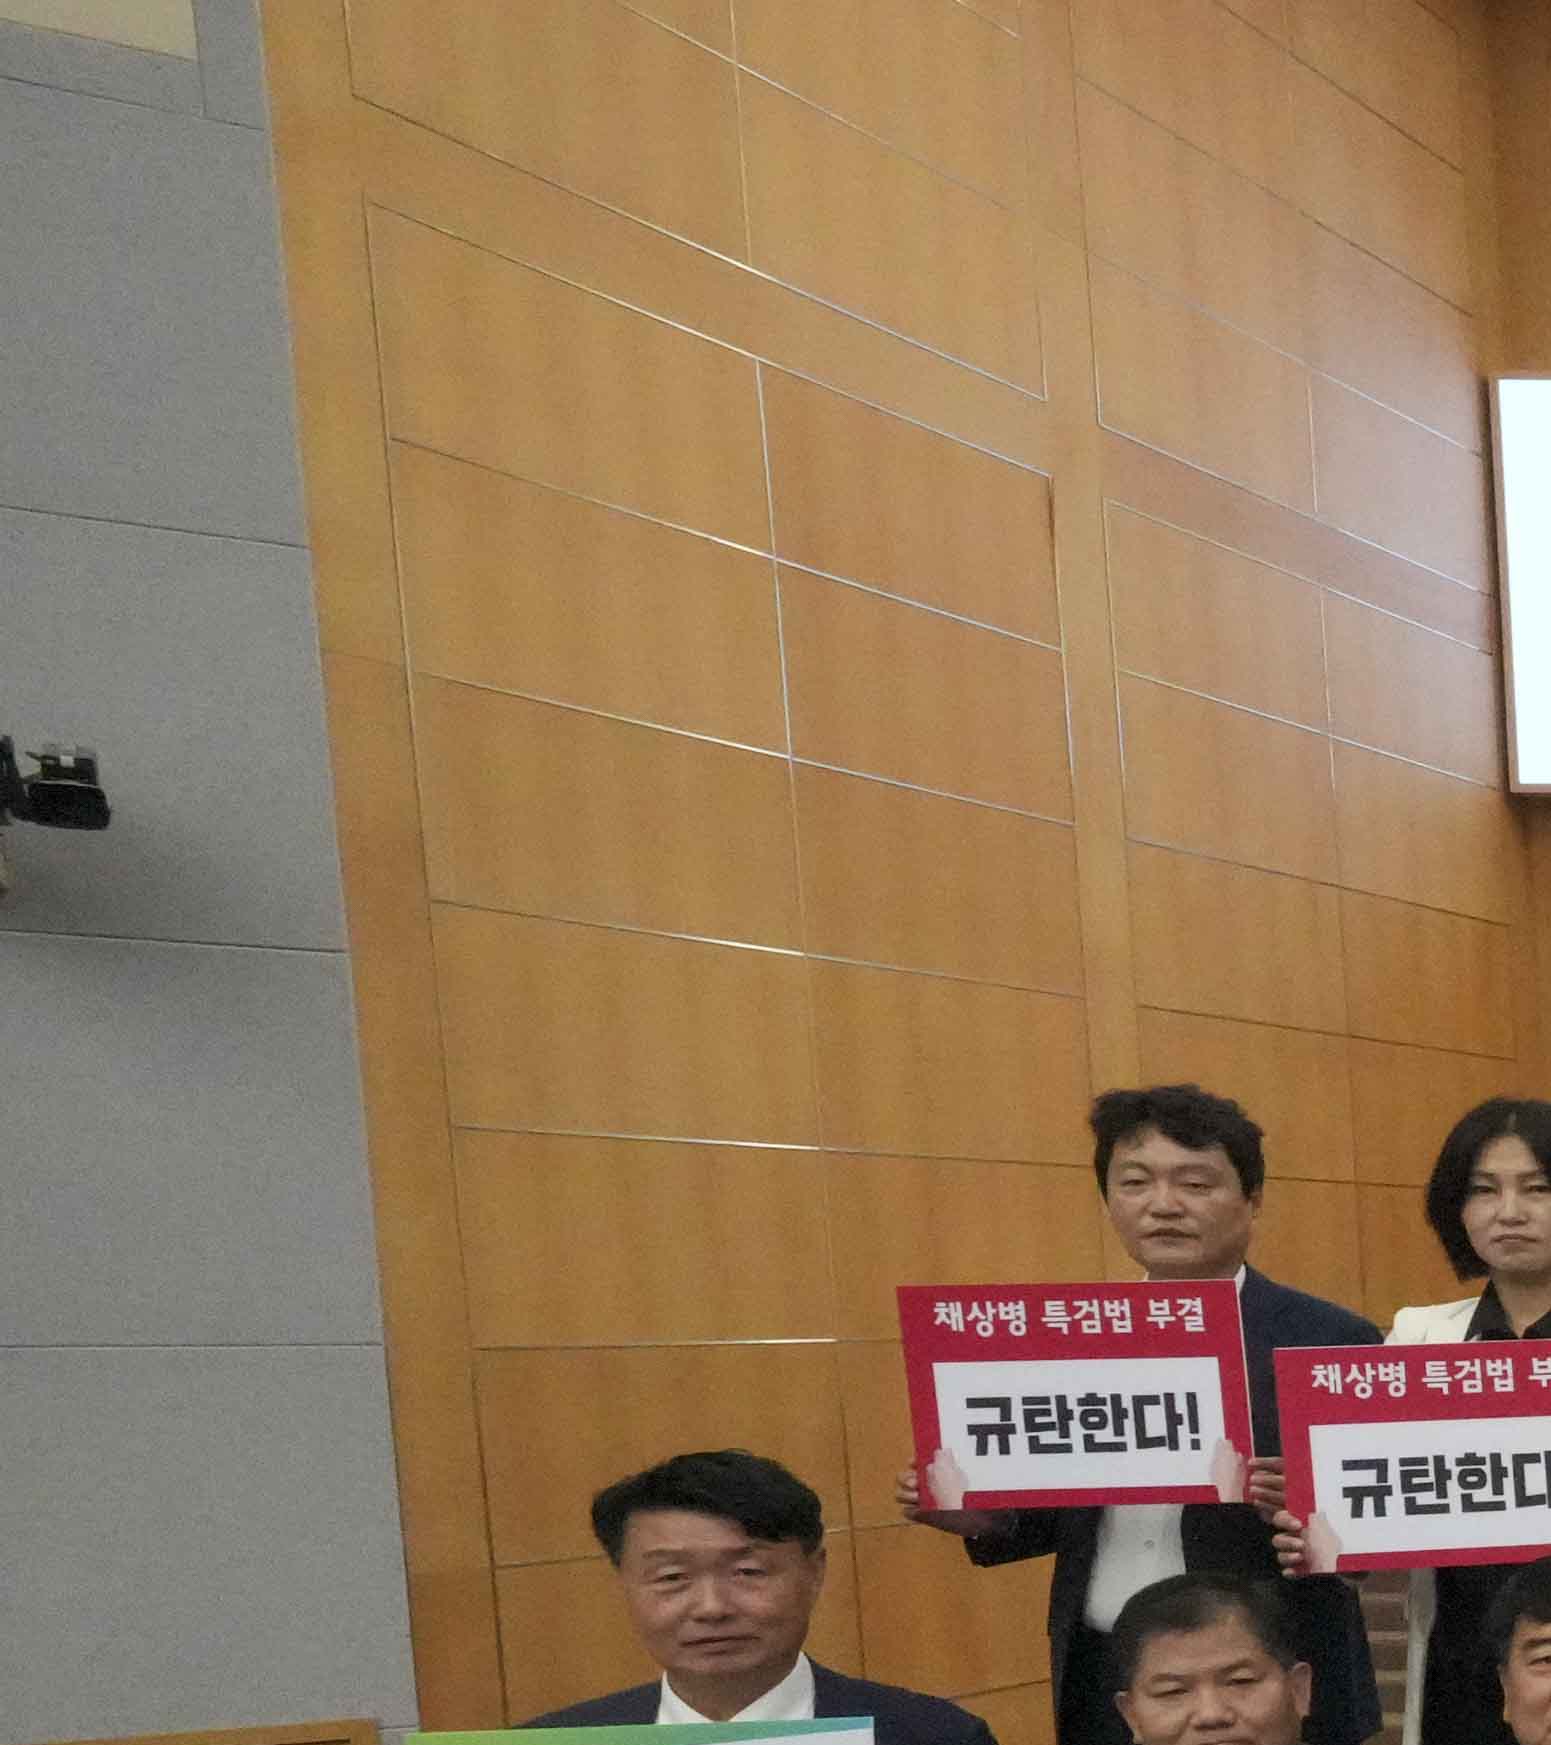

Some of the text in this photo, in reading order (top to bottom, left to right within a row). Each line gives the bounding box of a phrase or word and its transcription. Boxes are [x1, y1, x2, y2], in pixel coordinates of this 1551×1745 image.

[933, 1297, 1206, 1338] 채상병 특검법 부결
[1311, 1361, 1407, 1400] 채상병
[1421, 1357, 1515, 1395] 특검법
[965, 1391, 1201, 1457] 규탄한다!
